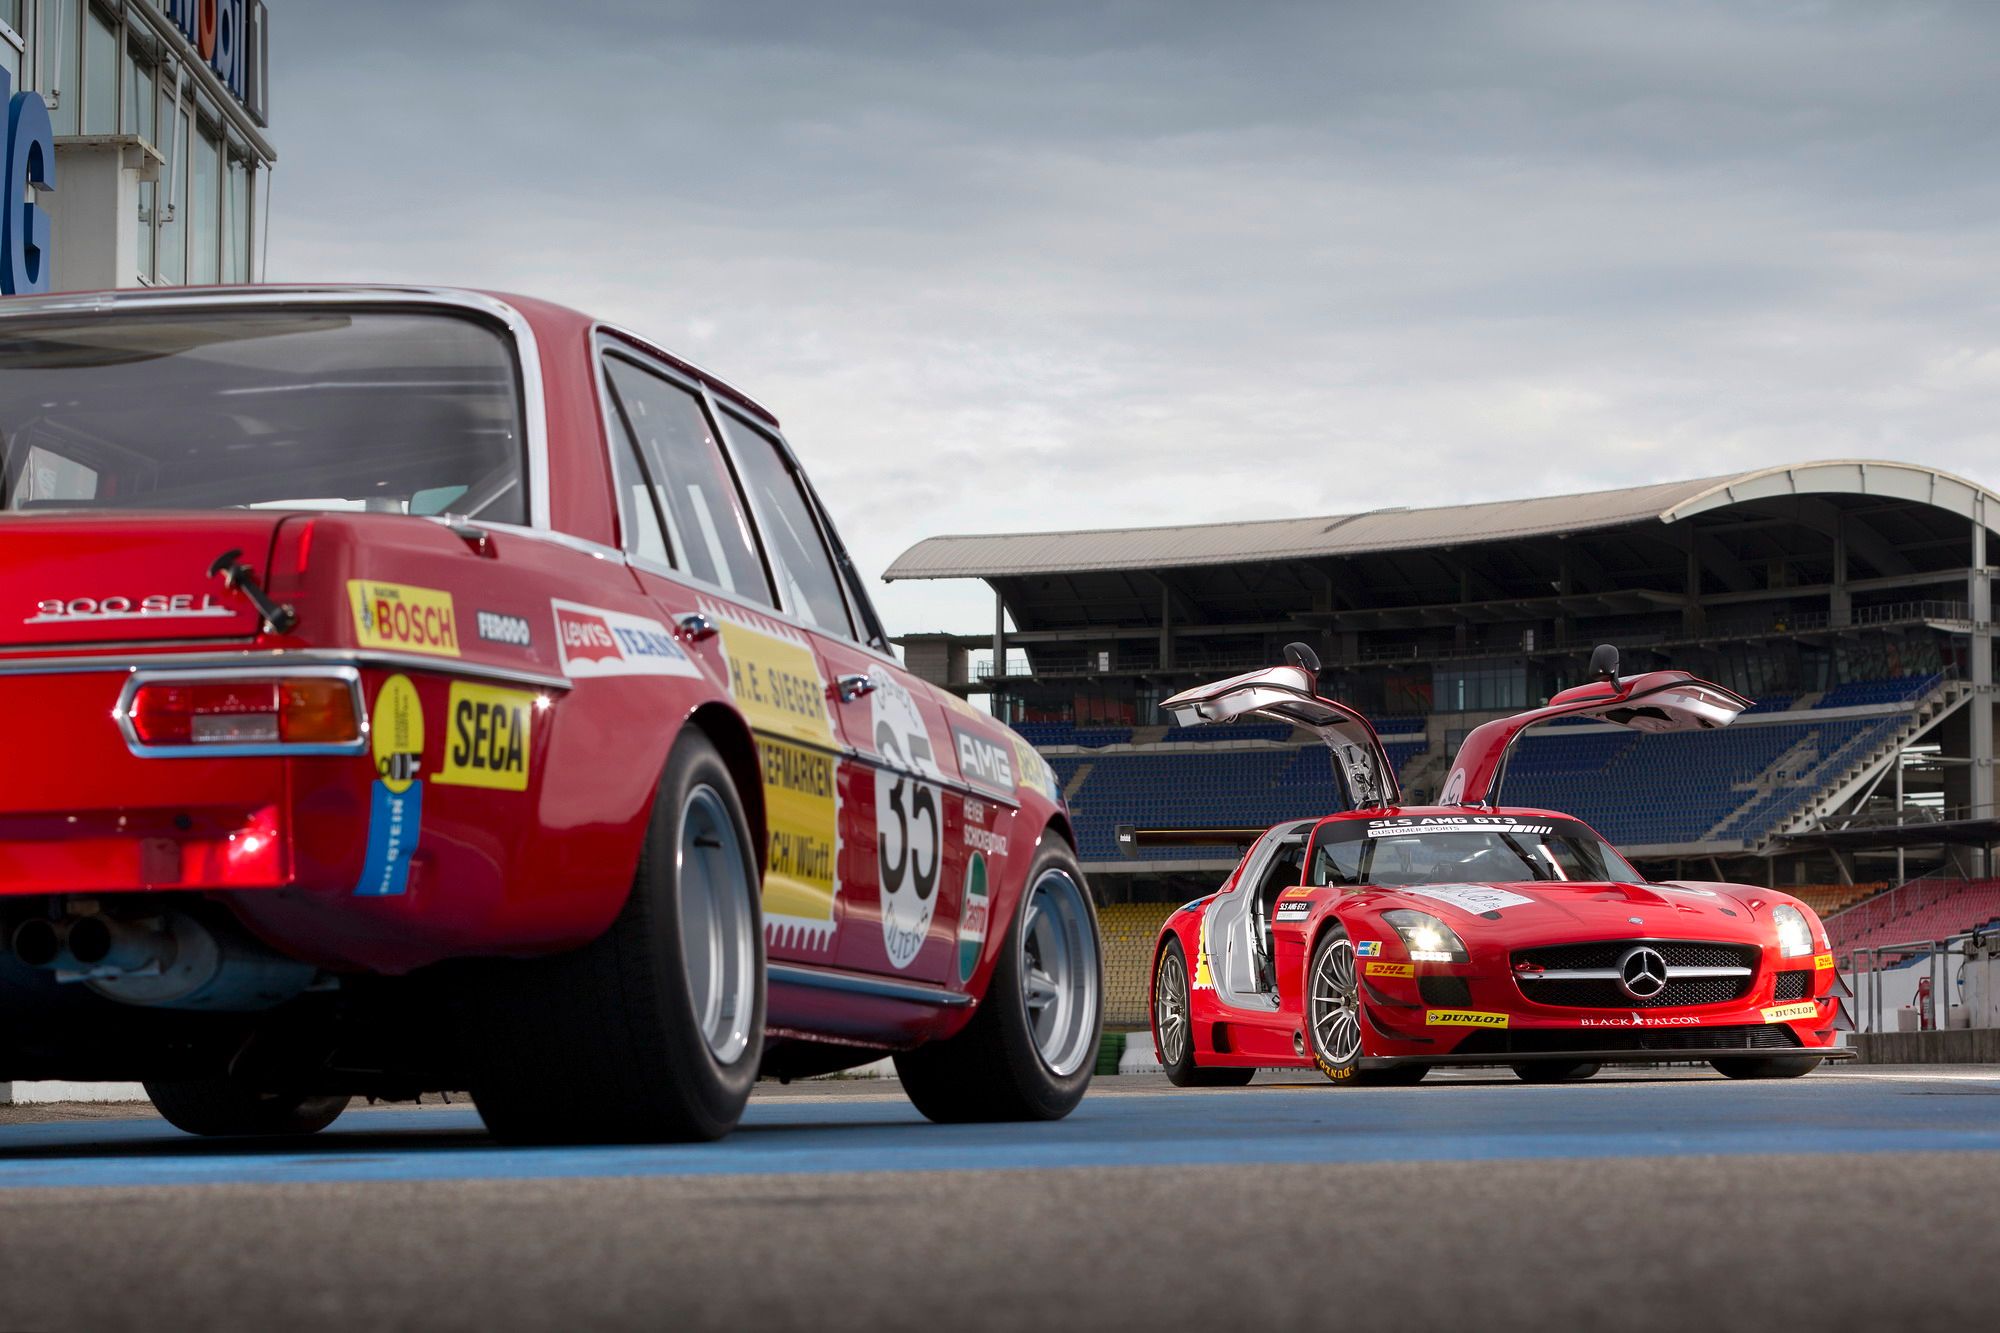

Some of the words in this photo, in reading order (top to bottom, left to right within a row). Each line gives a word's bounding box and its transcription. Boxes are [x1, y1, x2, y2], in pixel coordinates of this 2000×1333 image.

[37, 597, 130, 615] 300
[376, 600, 454, 648] BOSCH
[768, 668, 825, 720] SIEGER
[454, 700, 523, 772] SECA
[958, 732, 1014, 789] AMG
[1369, 818, 1412, 828] SLS
[1421, 817, 1468, 825] AMG
[1474, 816, 1518, 825] GT3
[1371, 827, 1423, 836] CUSTOMER
[1372, 964, 1406, 975] DHL
[1775, 1006, 1814, 1017] DUNLOP
[1440, 1014, 1506, 1024] DUNLOP
[1581, 1018, 1631, 1026] BLACK
[1645, 1016, 1701, 1025] FALCON
